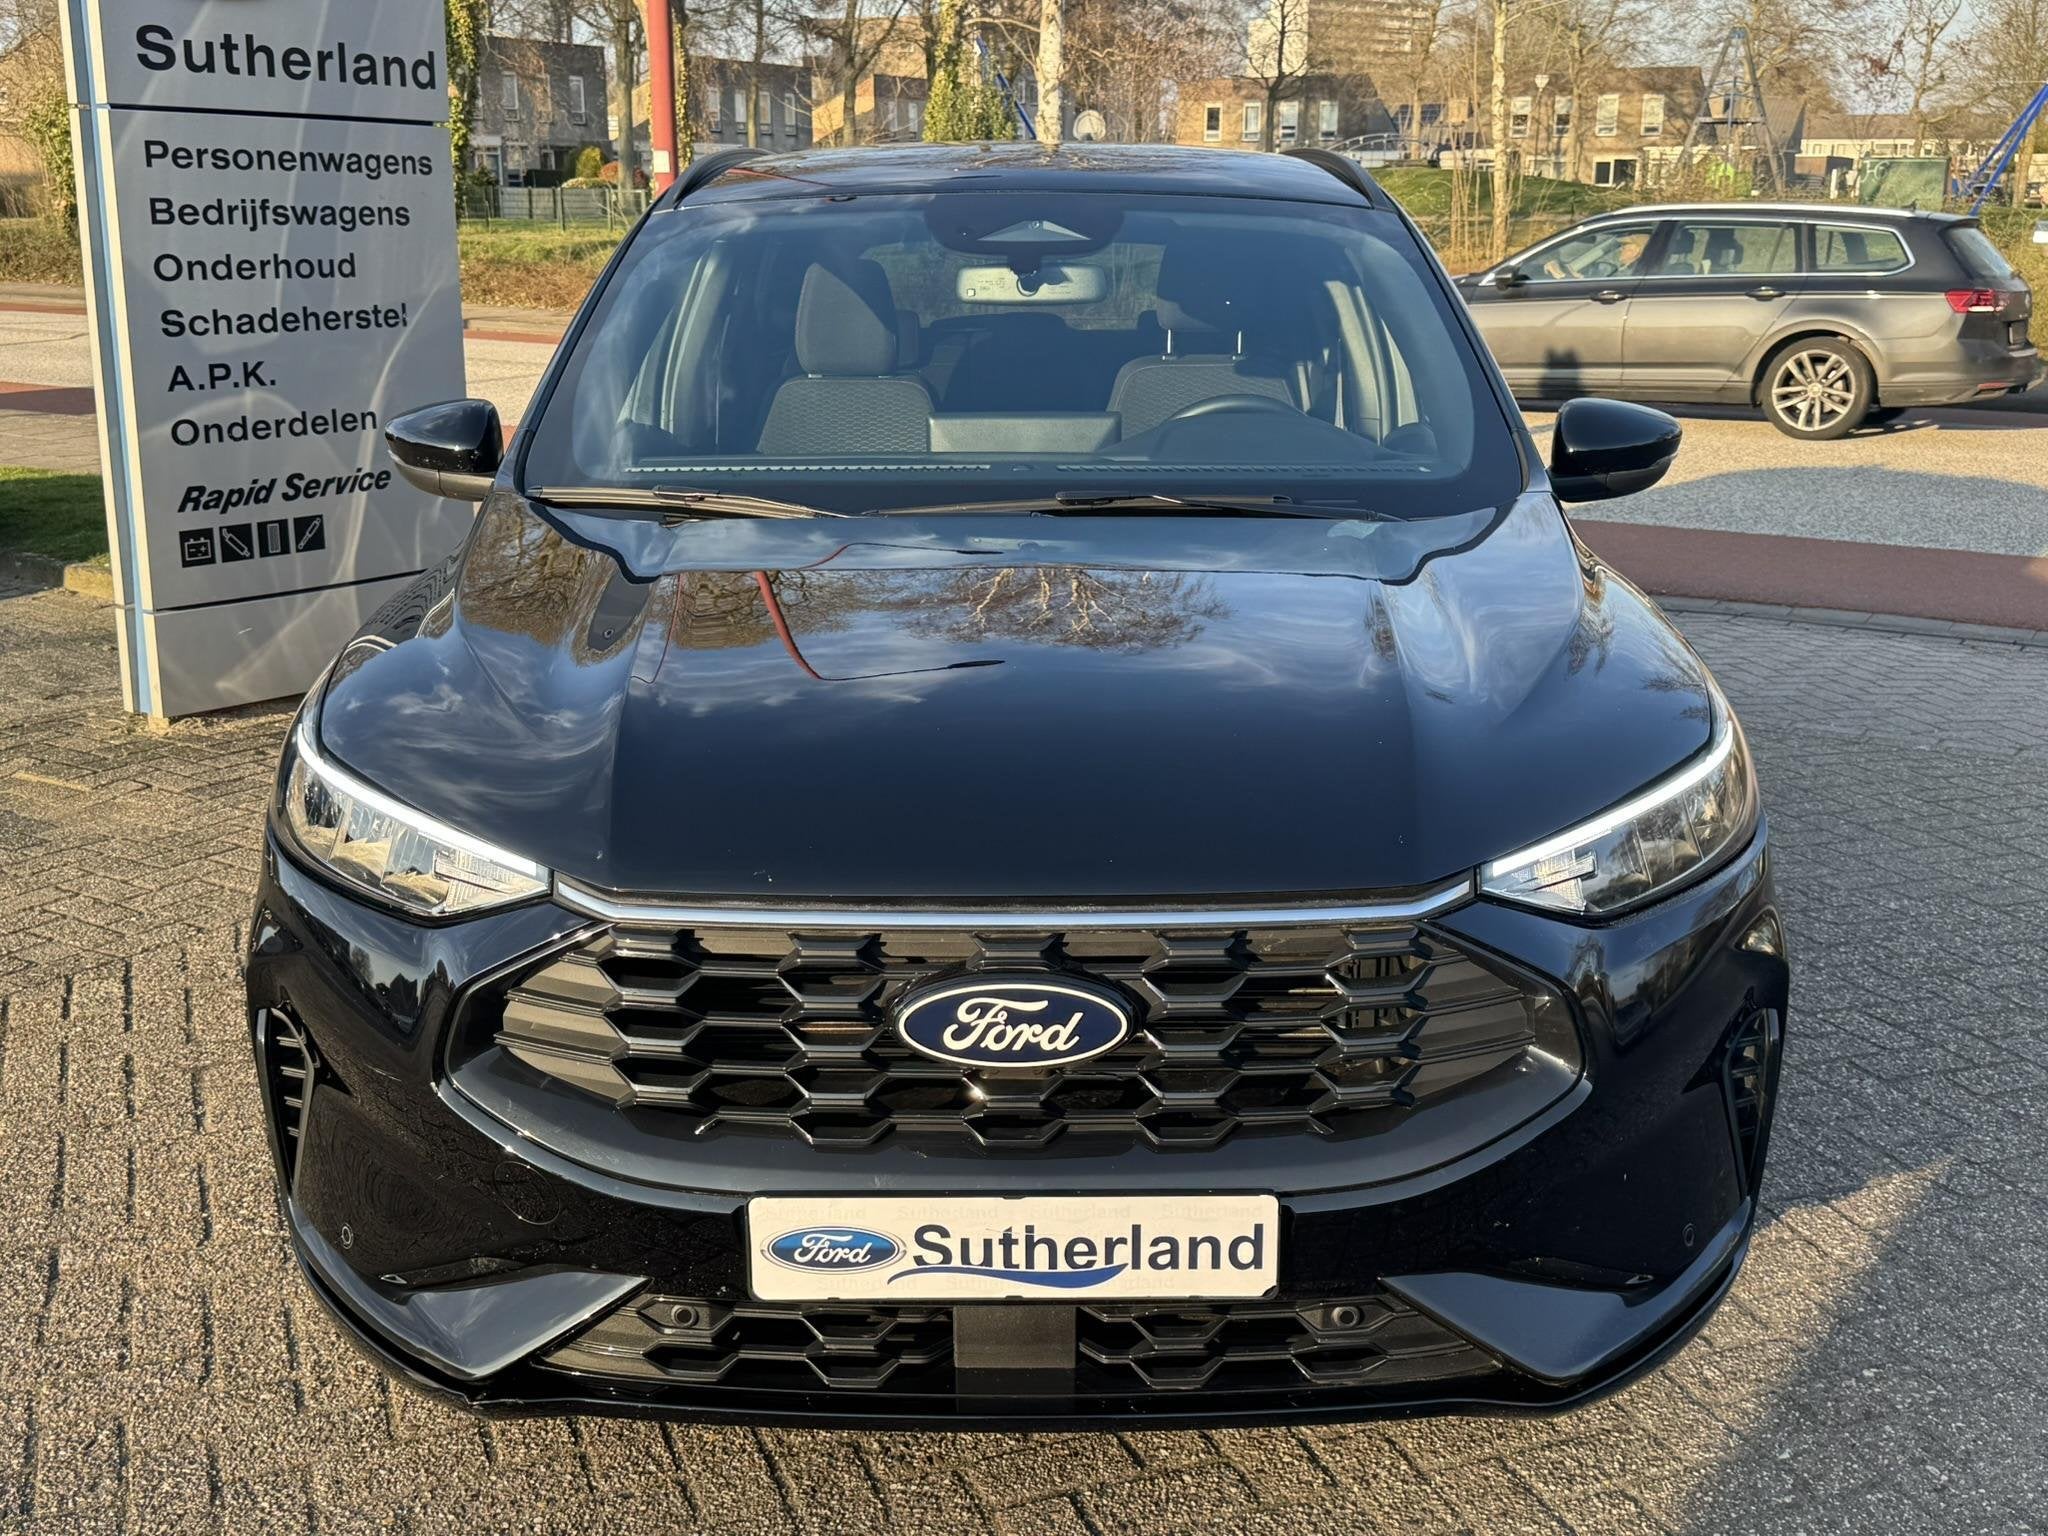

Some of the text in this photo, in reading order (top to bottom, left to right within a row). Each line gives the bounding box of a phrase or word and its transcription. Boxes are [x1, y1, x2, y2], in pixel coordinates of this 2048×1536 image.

[136, 24, 437, 90] Sutherland
[144, 139, 433, 180] Personenwagens
[149, 197, 411, 232] Bedrijfswagens
[153, 252, 357, 282] Onderhoud
[160, 303, 408, 338] Schadeherstel
[167, 361, 277, 393] A.P.K.
[171, 408, 378, 447] Onderdelen
[177, 467, 392, 515] Rapid Service
[942, 996, 1084, 1052] Ford
[793, 1223, 1264, 1271] Ford Sutherland
